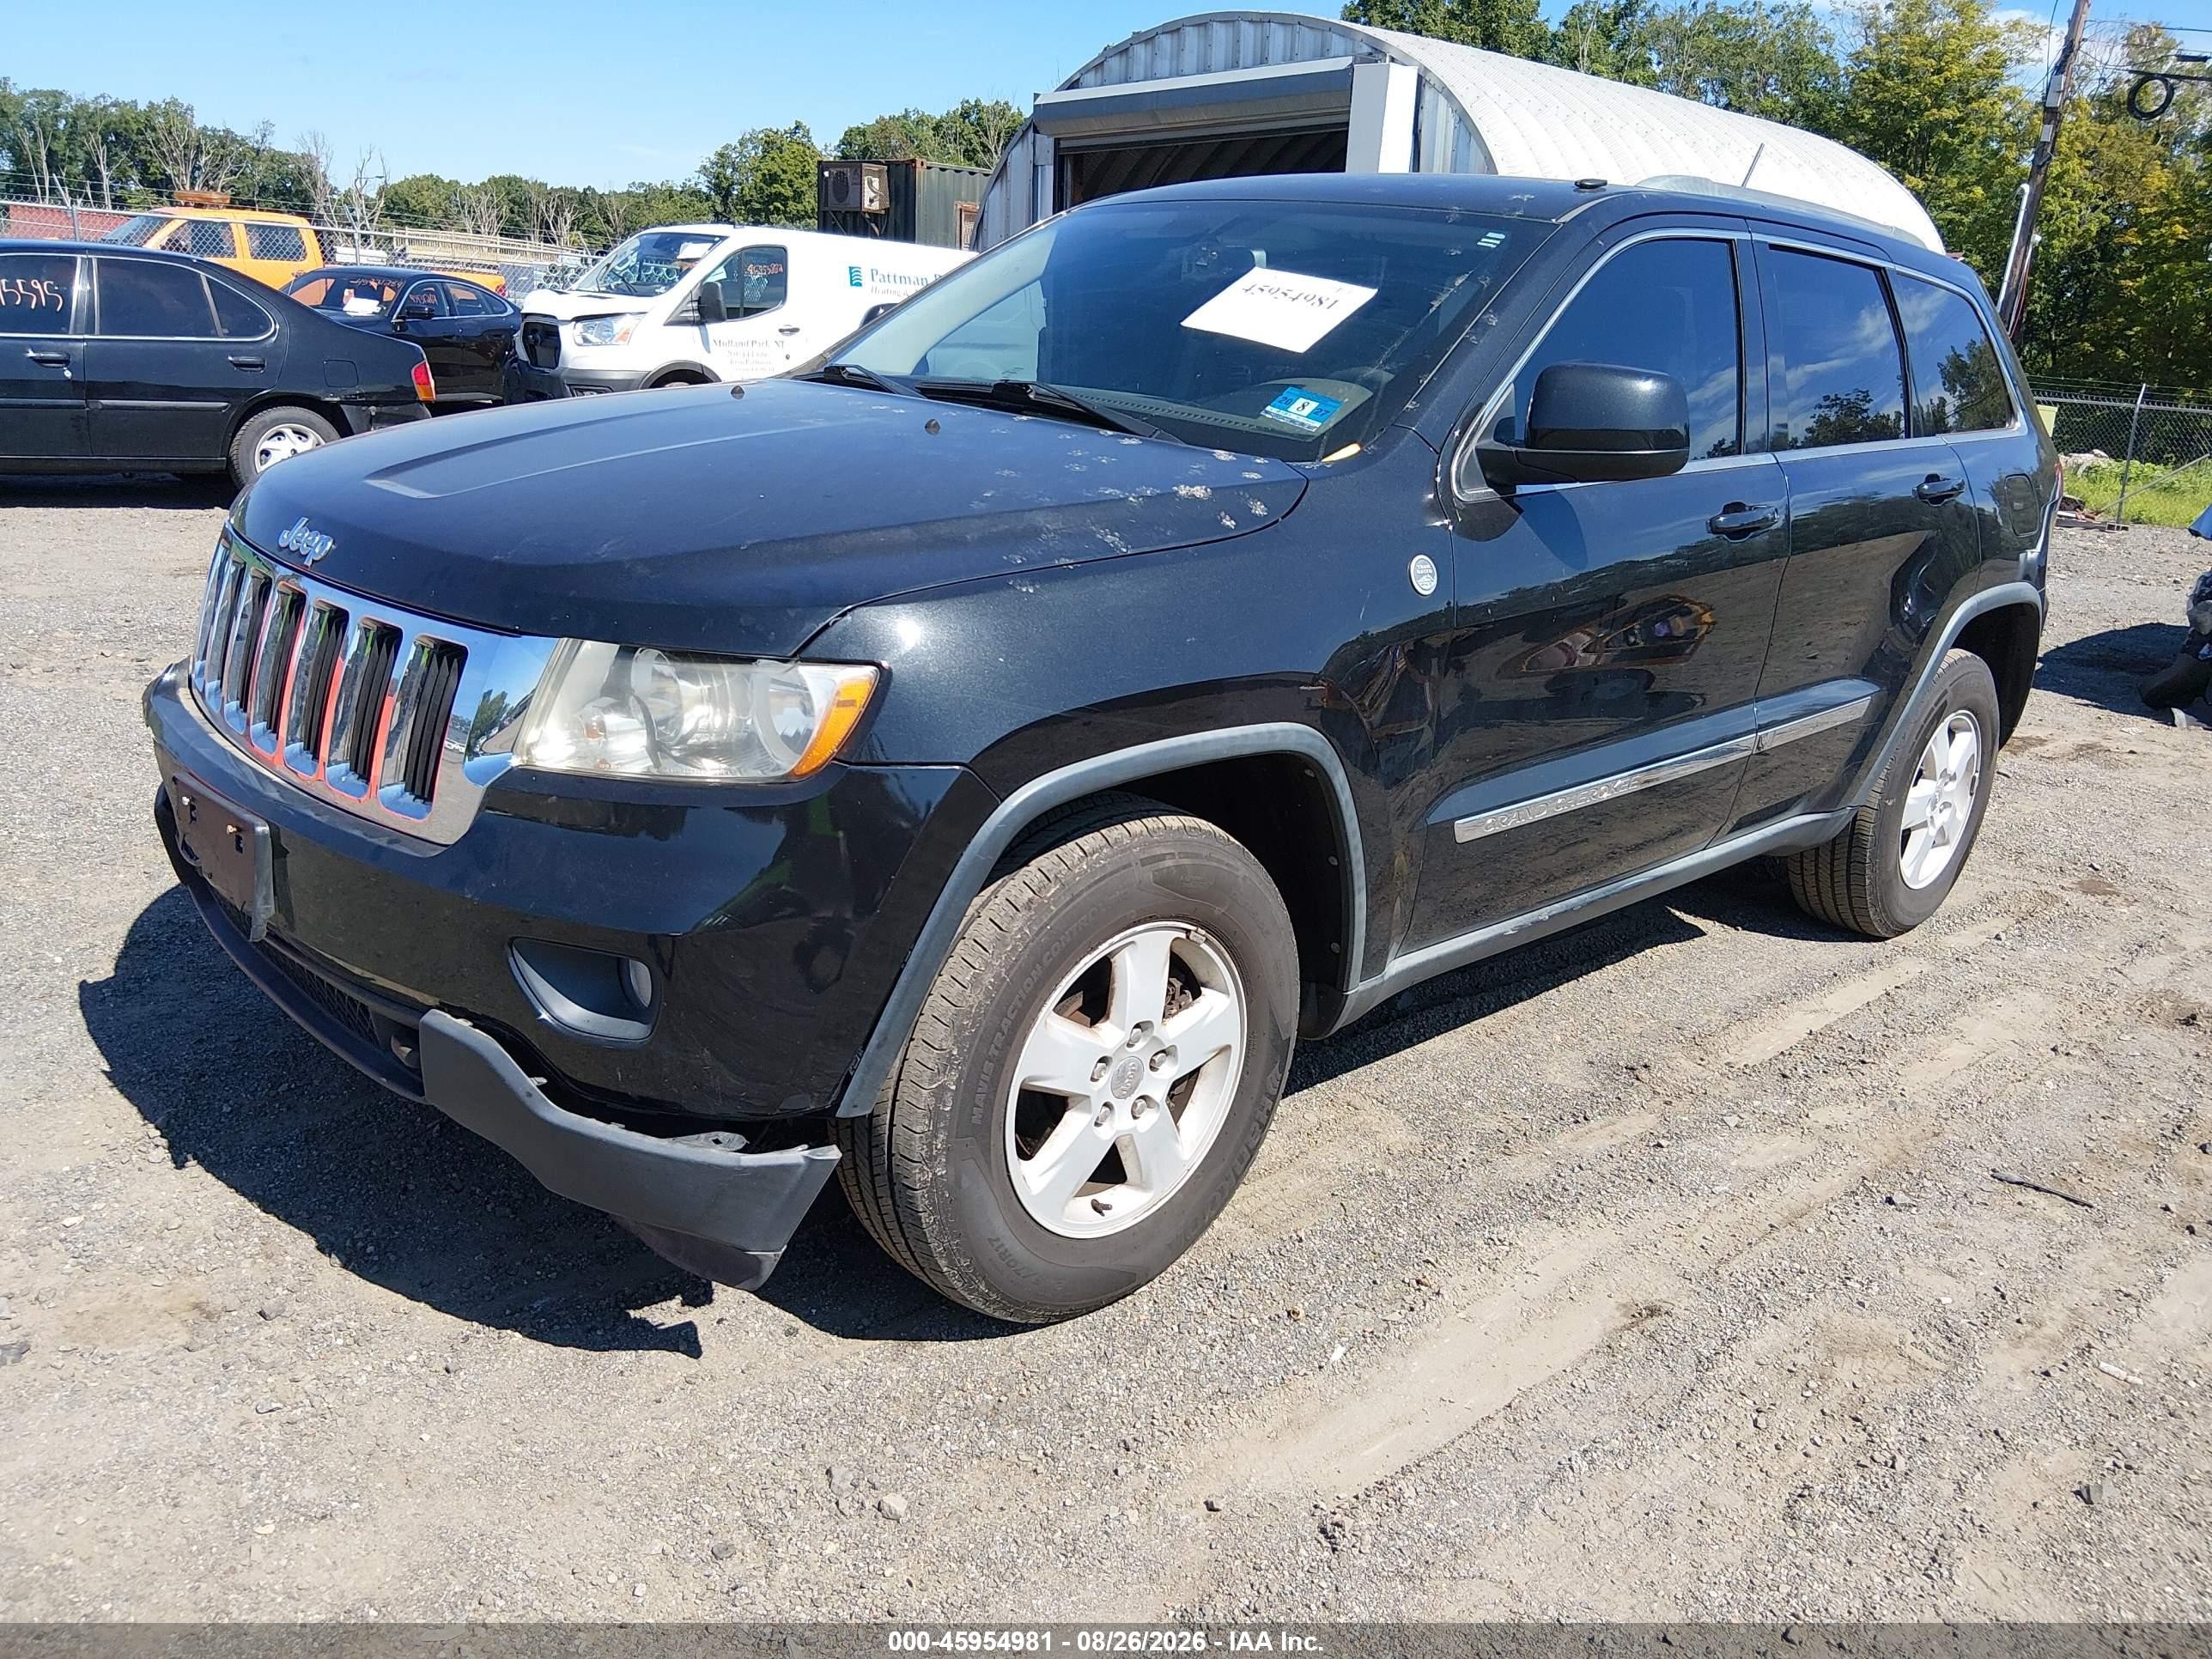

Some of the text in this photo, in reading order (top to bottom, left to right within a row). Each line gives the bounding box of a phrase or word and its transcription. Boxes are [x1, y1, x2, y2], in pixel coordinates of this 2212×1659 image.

[870, 268, 928, 286] Pattman
[1277, 396, 1294, 406] 20
[1296, 401, 1310, 412] 8
[1313, 408, 1331, 418] 27
[278, 516, 334, 568] Jeep
[1483, 775, 1640, 832] GRAND CHEROKEE
[971, 1060, 995, 1126] MAVIS
[988, 962, 1045, 1060] TRACTION
